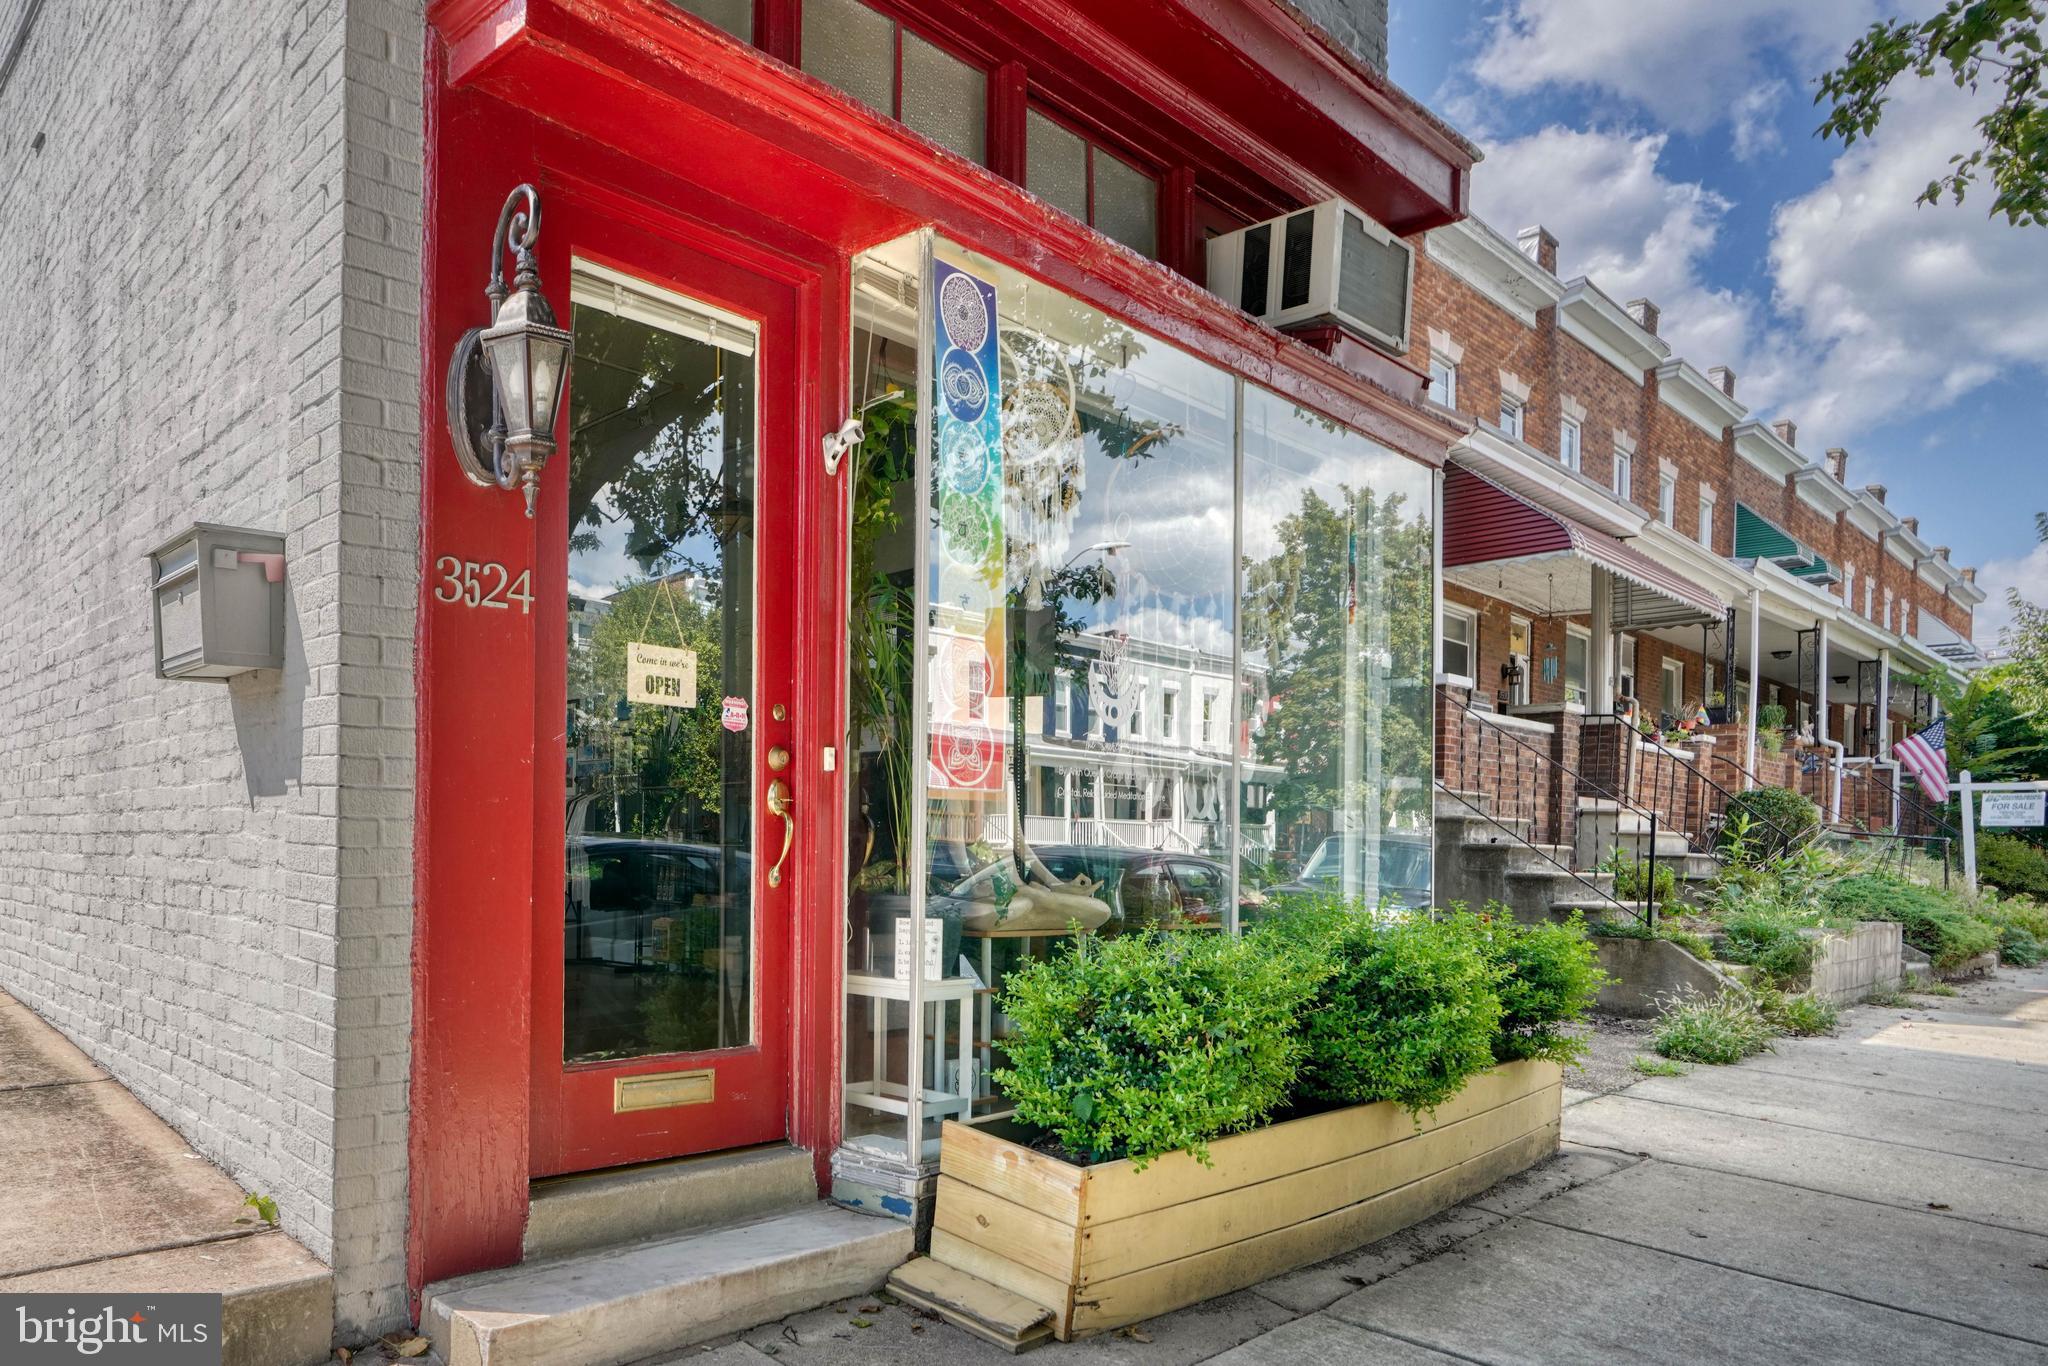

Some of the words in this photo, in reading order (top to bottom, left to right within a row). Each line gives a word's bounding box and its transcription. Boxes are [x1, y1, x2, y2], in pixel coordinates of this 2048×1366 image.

[435, 556, 535, 615] 3524
[636, 653, 658, 666] Come
[659, 657, 668, 666] in
[645, 674, 681, 697] OPEN
[1991, 802, 2010, 810] FOR
[2012, 801, 2035, 810] SALE
